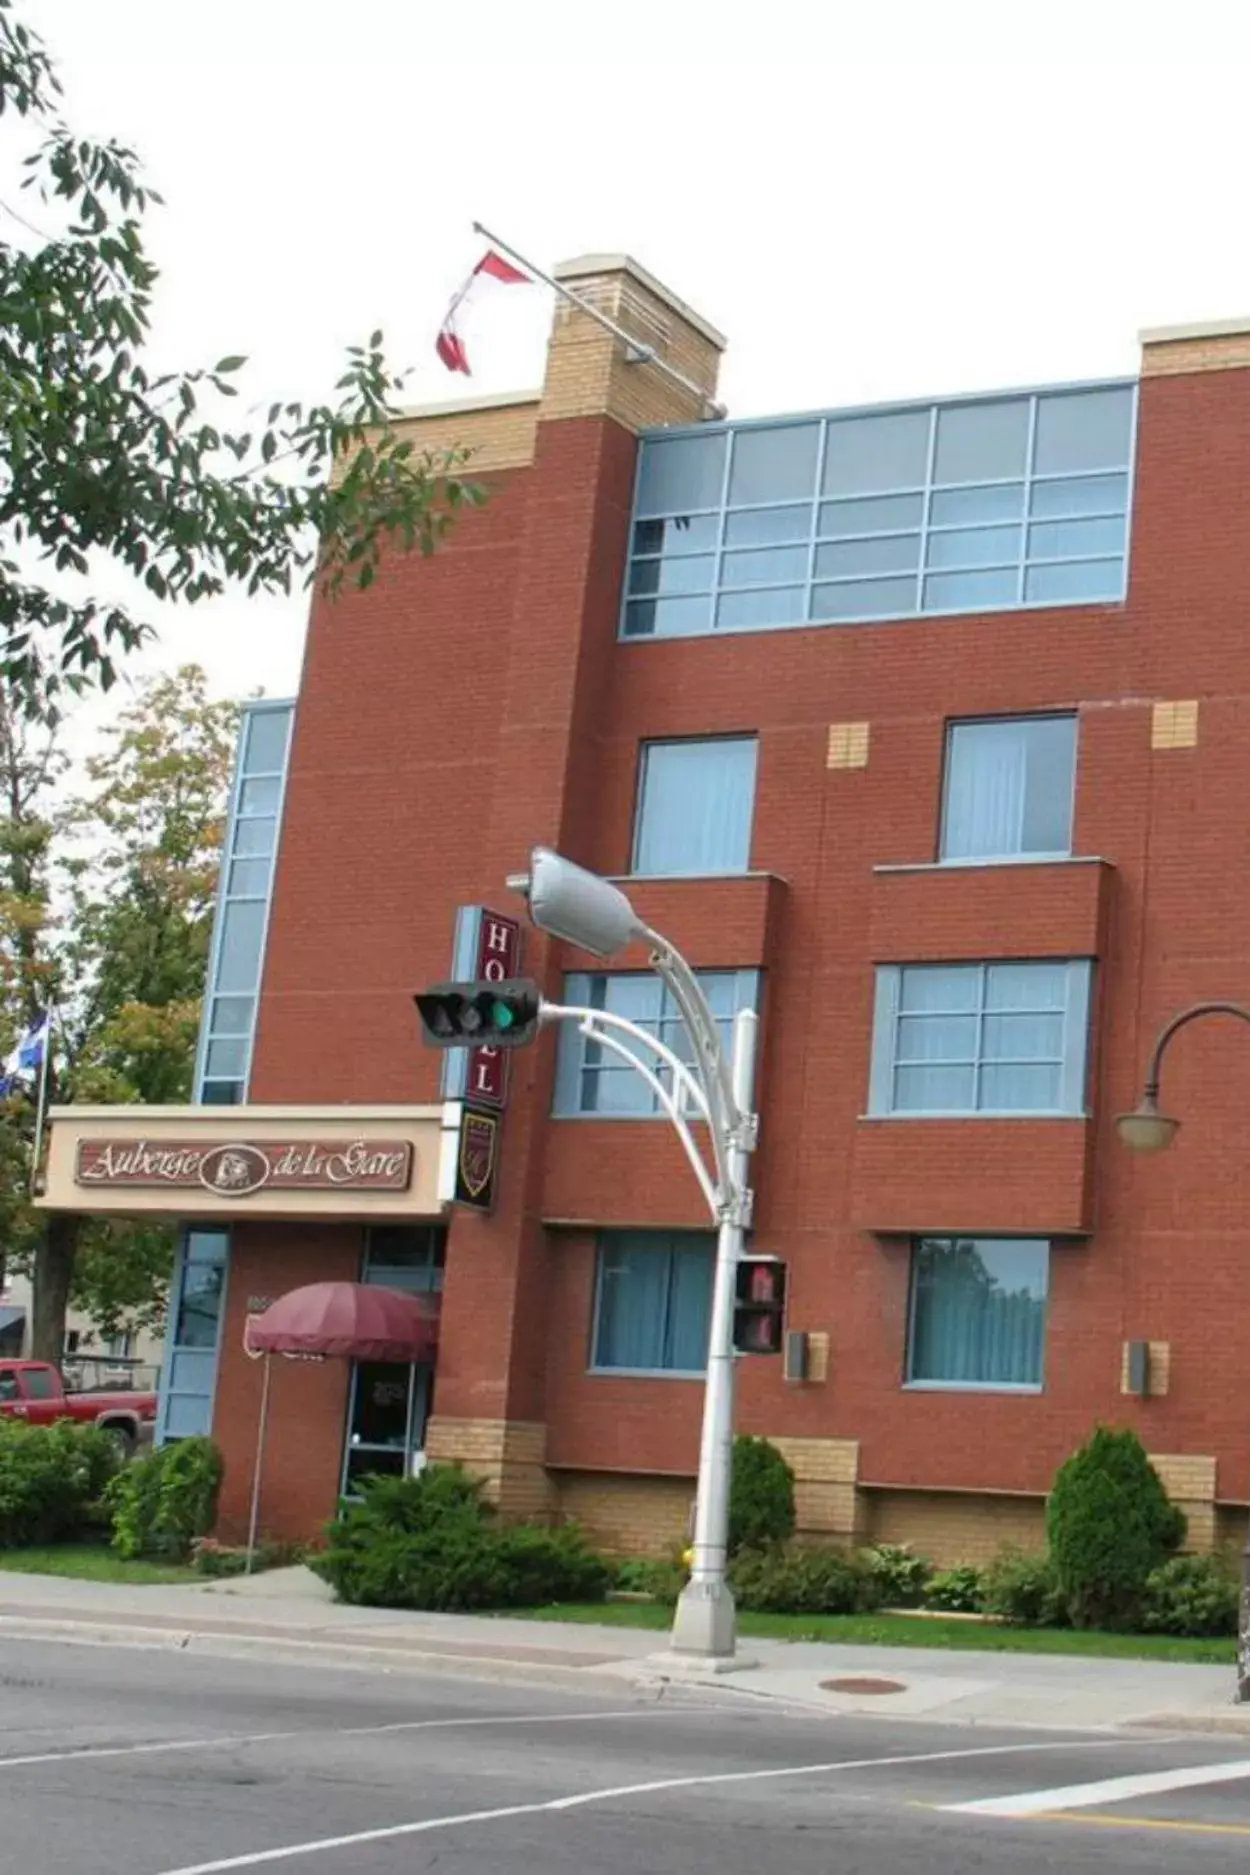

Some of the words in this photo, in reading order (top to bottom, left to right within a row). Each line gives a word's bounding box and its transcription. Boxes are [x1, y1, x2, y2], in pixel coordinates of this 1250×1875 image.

[475, 923, 508, 1093] HOL
[82, 1140, 200, 1179] Auberge
[273, 1146, 301, 1177] de
[326, 1137, 404, 1182] Gare
